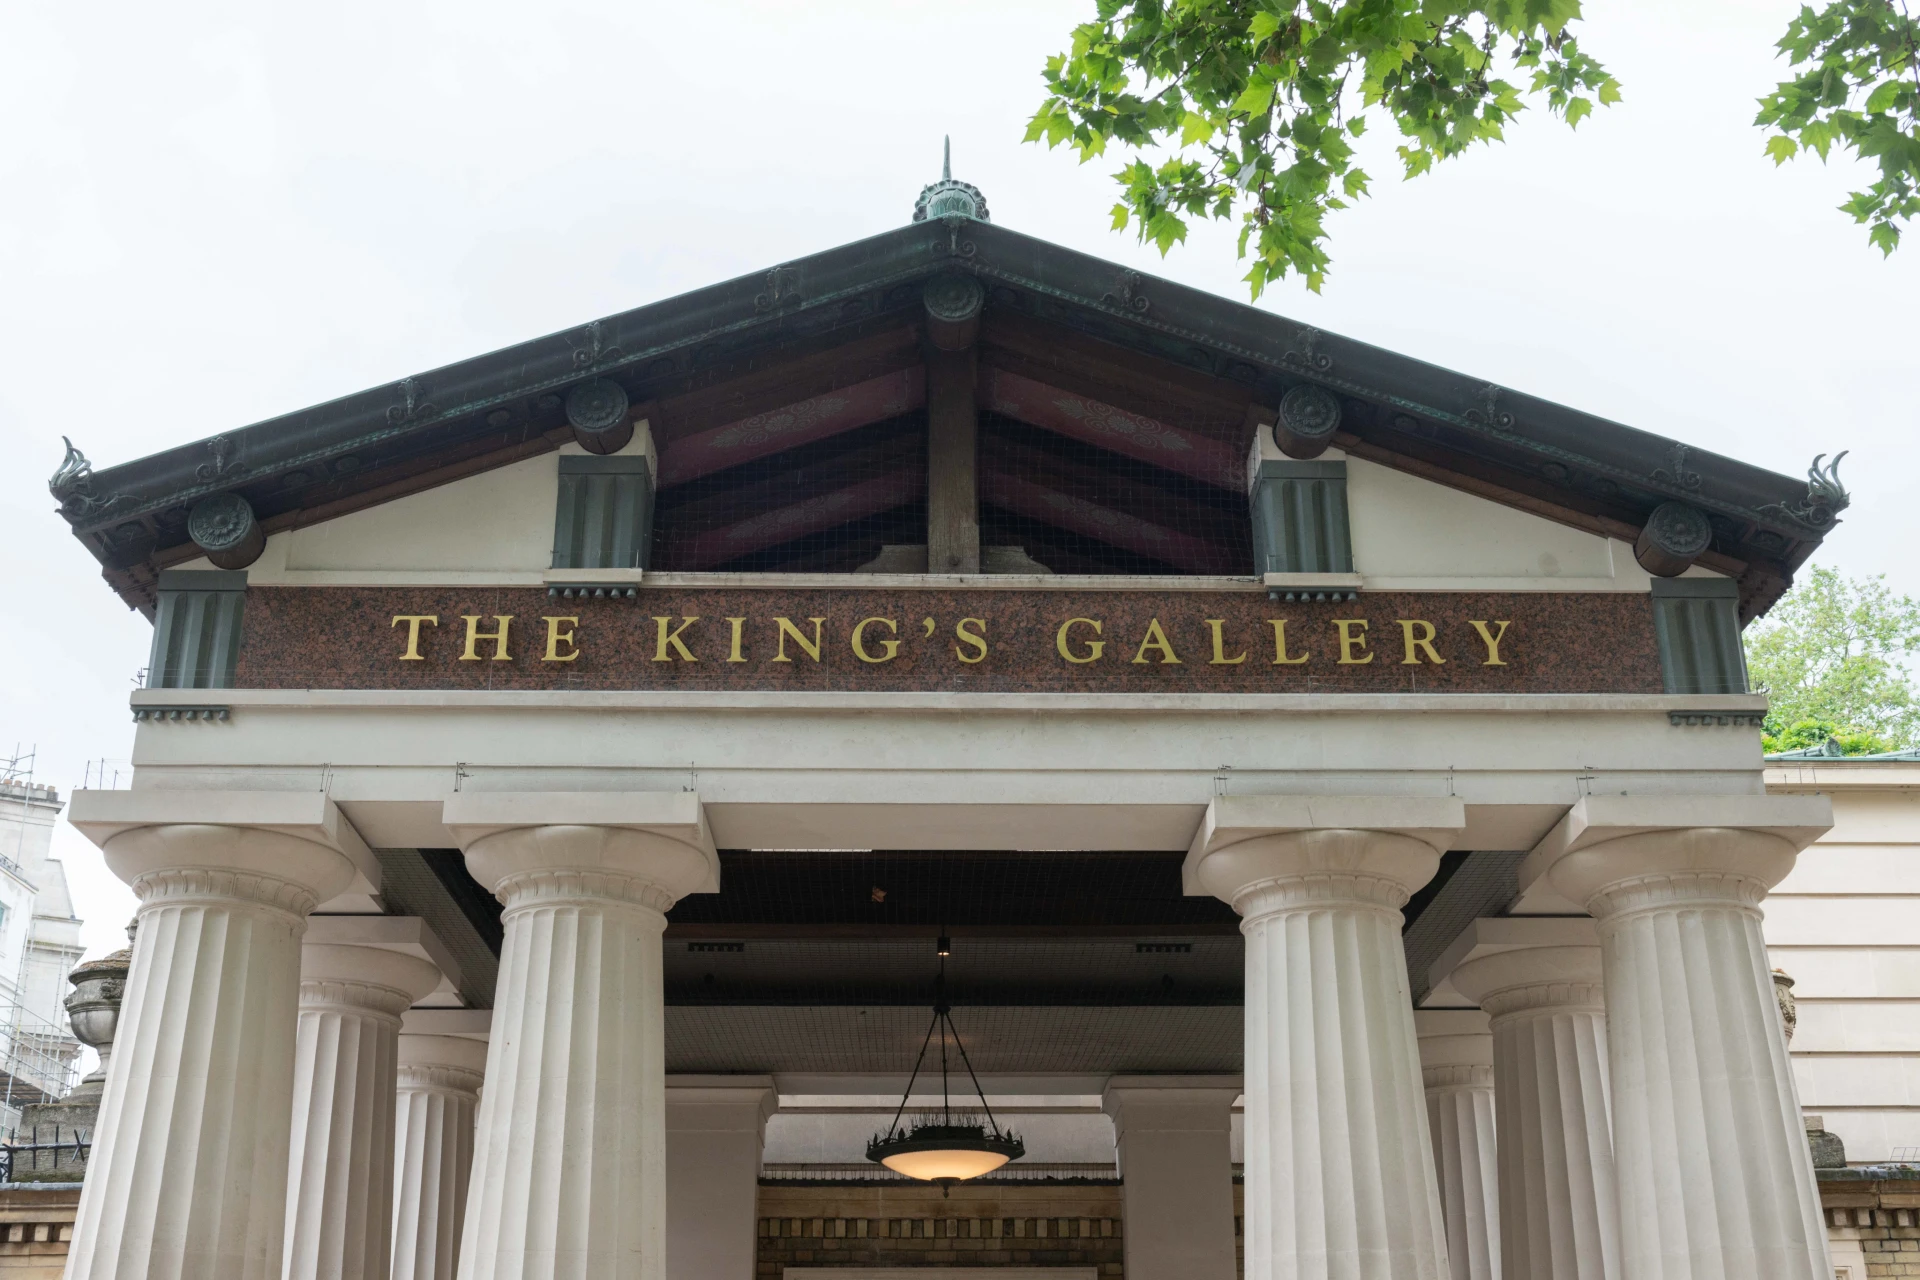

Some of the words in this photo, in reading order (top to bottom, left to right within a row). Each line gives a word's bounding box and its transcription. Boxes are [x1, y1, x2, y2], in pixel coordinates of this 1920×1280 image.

[391, 614, 581, 662] THE
[651, 615, 989, 664] KING'S
[1055, 617, 1512, 666] GALLERY
